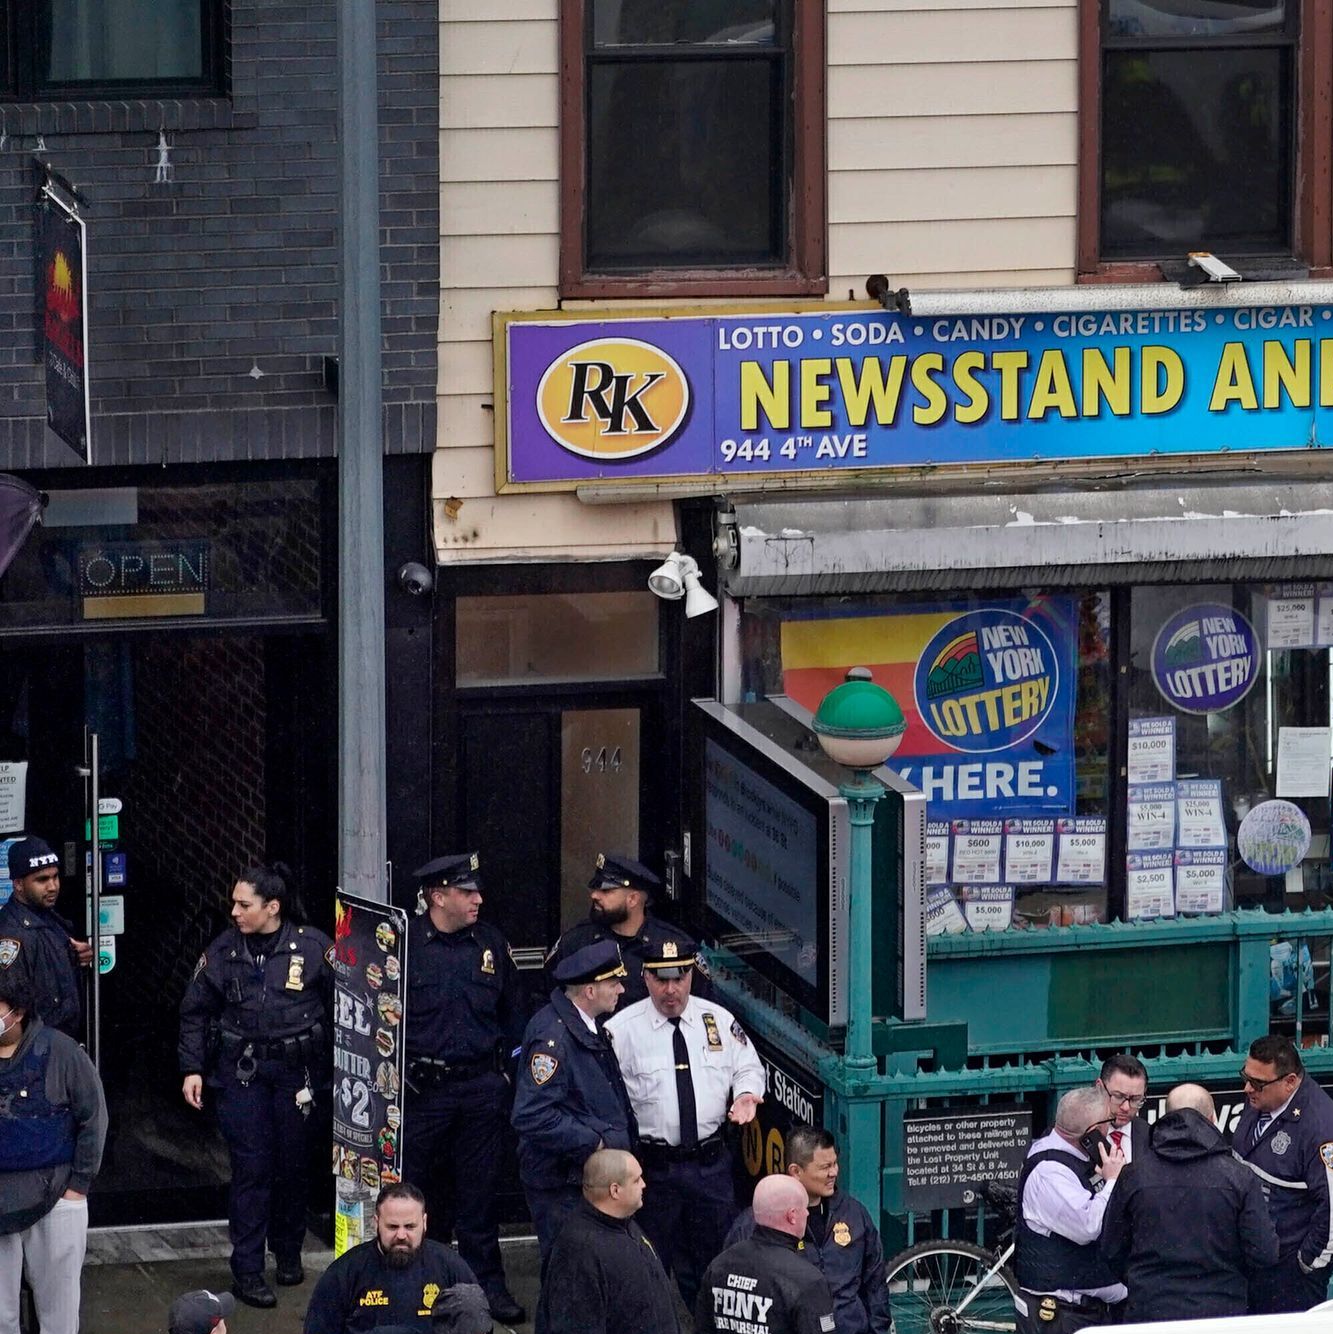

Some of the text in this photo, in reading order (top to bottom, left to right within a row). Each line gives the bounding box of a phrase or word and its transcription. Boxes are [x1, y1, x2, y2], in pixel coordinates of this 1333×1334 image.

[719, 325, 804, 350] LOTTO
[831, 321, 905, 346] SODA
[932, 318, 1025, 342] CANDY
[1052, 309, 1207, 337] CIGARETTES
[1233, 305, 1314, 331] CIGAR
[740, 344, 1187, 431] NEWSSTAND
[720, 433, 868, 463] 944 4TH AVE
[86, 553, 203, 586] OPEN
[1203, 617, 1236, 635] NEW
[981, 625, 1029, 650] NEW
[1207, 633, 1248, 660] YORK
[986, 647, 1045, 683] YORK
[1165, 652, 1252, 699] LOTTERY
[928, 675, 1051, 738] LOTTERY
[1132, 740, 1167, 750] $10,000
[922, 760, 1058, 801] HERE.
[967, 838, 990, 848] $600
[1015, 840, 1046, 848] $10,000
[1069, 838, 1097, 847] $5,000
[975, 906, 1002, 914] $5,000
[907, 1124, 941, 1133] Bicycles
[956, 1121, 977, 1129] other
[980, 1118, 1016, 1129] property
[907, 1127, 1029, 1143] attached to these railings will
[907, 1146, 918, 1154] be
[920, 1143, 957, 1153] removed
[959, 1141, 975, 1150] and
[978, 1139, 1015, 1149] delivered
[907, 1151, 999, 1165] the Lost Property Unit
[907, 1161, 1008, 1176] located at 34 St Av
[930, 1170, 1019, 1186] (212) 712-4500/4501
[727, 1273, 758, 1291] CHIEF
[359, 1297, 389, 1307] POLICE
[365, 1290, 384, 1300] ATF
[712, 1286, 774, 1324] FDNY
